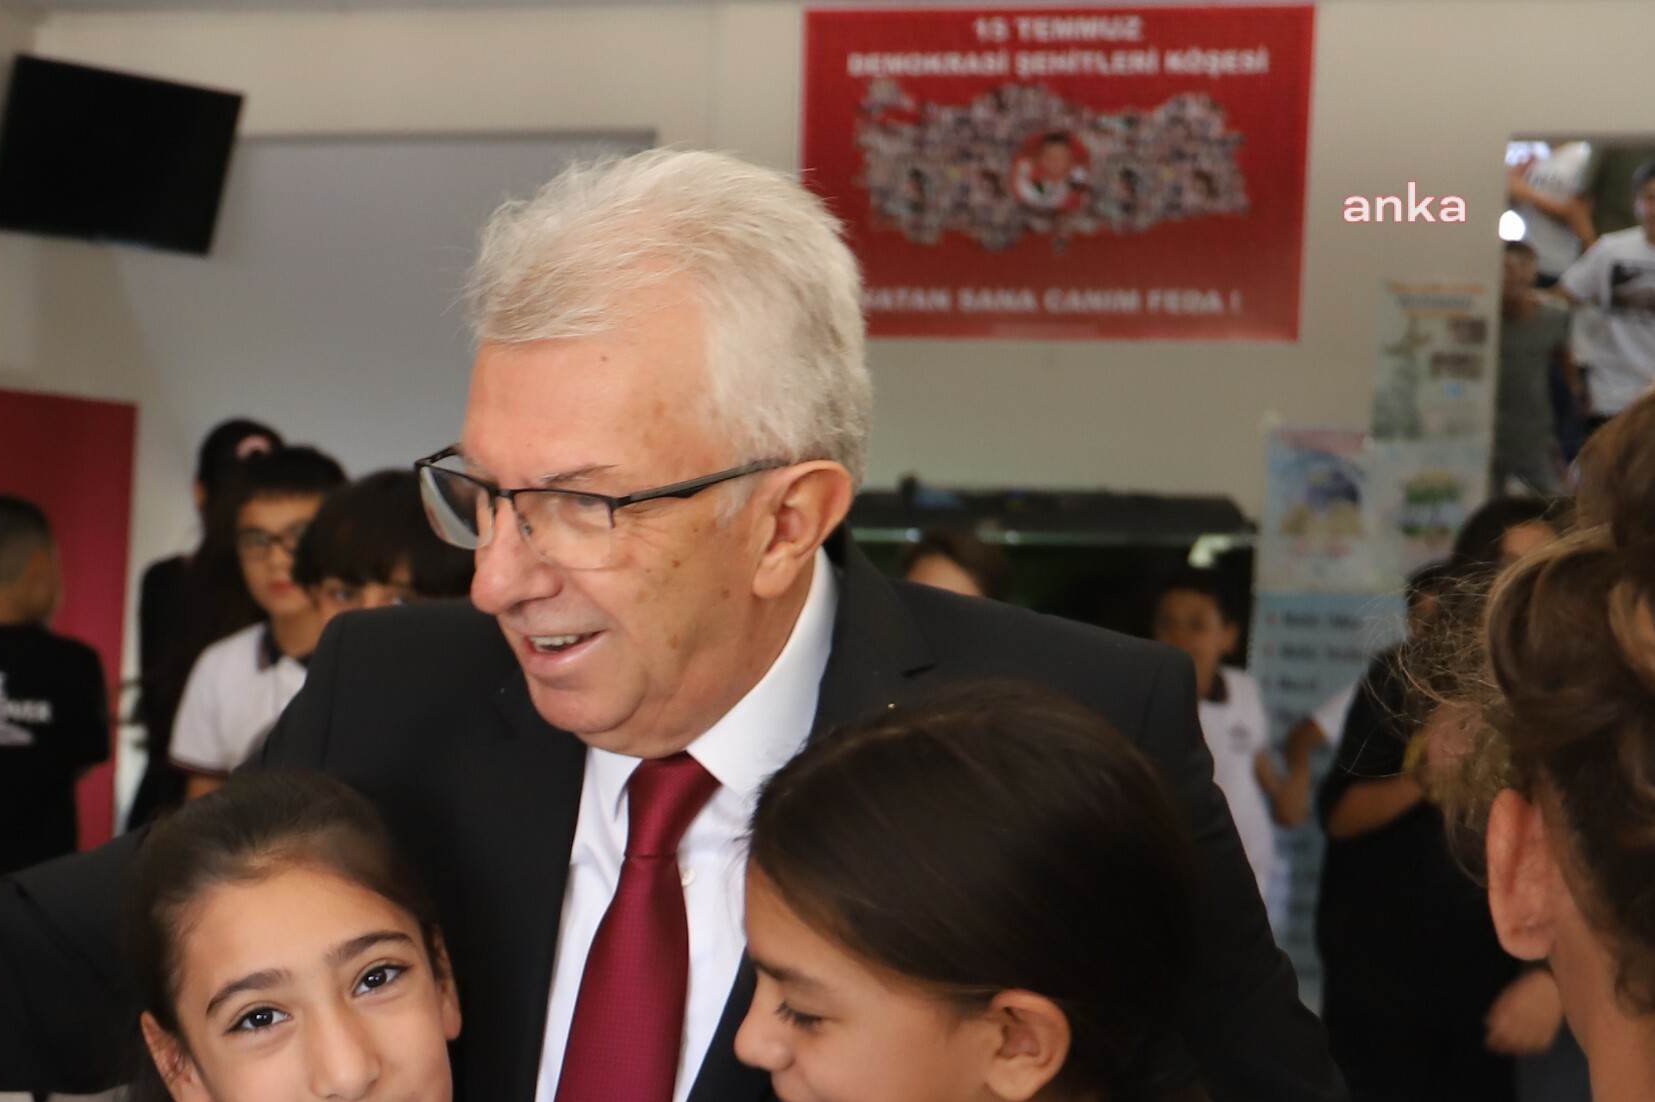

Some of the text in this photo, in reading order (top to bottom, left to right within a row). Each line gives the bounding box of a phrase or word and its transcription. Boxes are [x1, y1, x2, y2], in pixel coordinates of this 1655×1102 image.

[974, 15, 1143, 42] 15 TEMMUZ
[847, 44, 1269, 78] DEMOKRASİ ŞEHİTLERİ KÖŞESİ
[957, 287, 1038, 313] SANA
[1043, 287, 1141, 314] CANIM
[1146, 288, 1225, 315] FEDA
